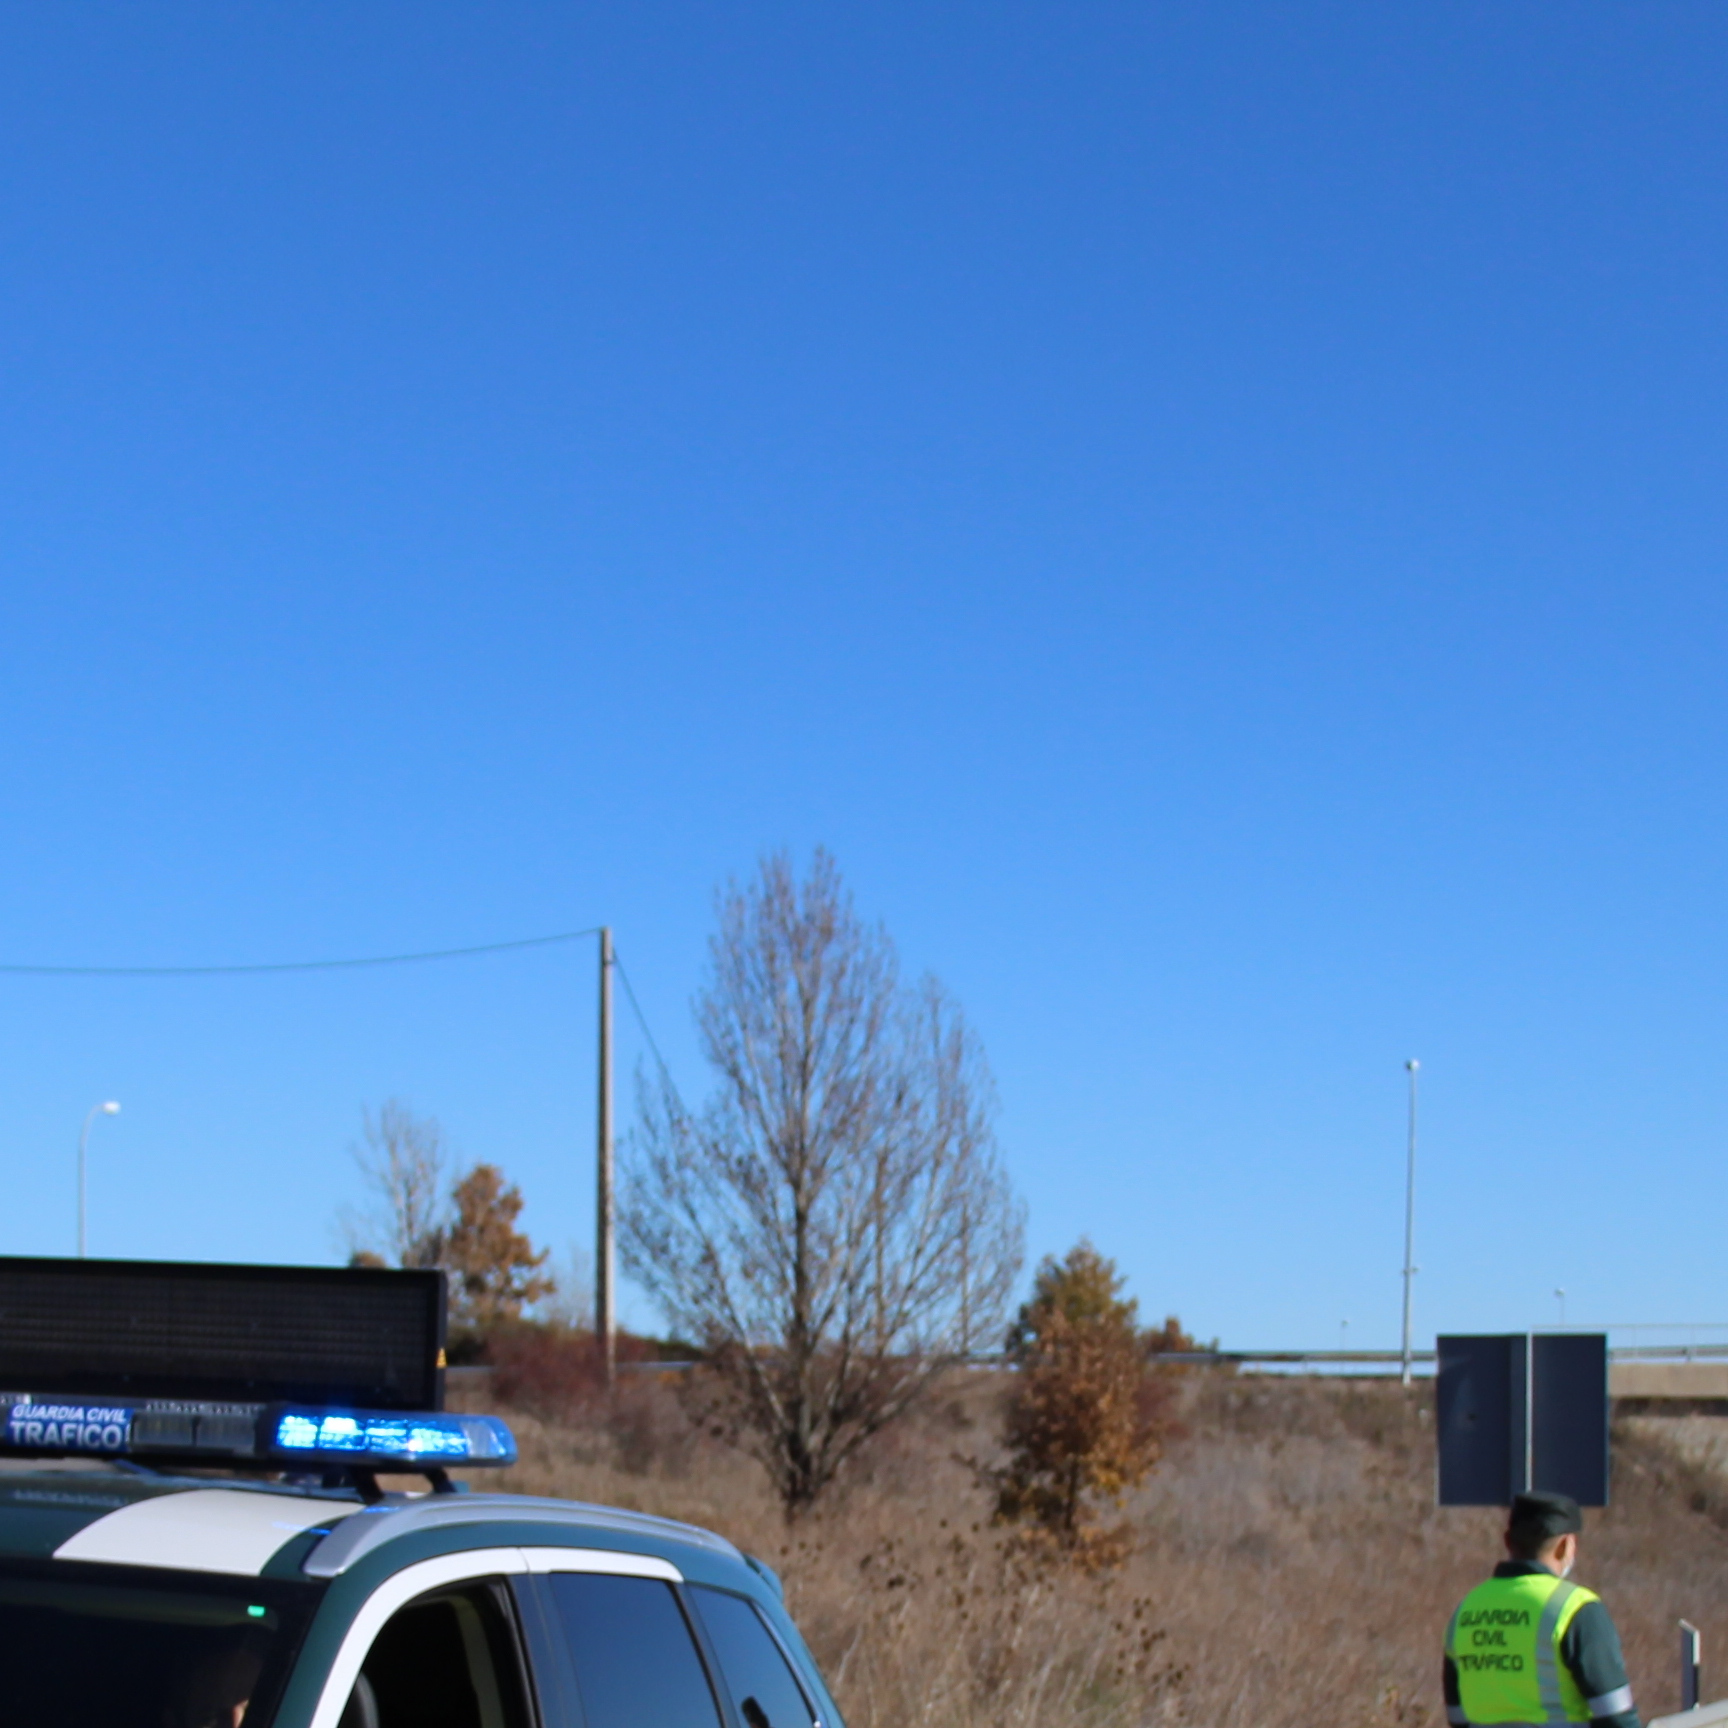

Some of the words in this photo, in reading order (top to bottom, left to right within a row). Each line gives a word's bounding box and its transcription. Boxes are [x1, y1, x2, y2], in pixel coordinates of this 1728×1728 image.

[12, 1405, 85, 1420] GUARDIA
[86, 1408, 127, 1423] CIVIL
[10, 1421, 122, 1449] TRAFICO
[1459, 1609, 1530, 1627] GUARDIA
[1472, 1629, 1508, 1647] CIVIL
